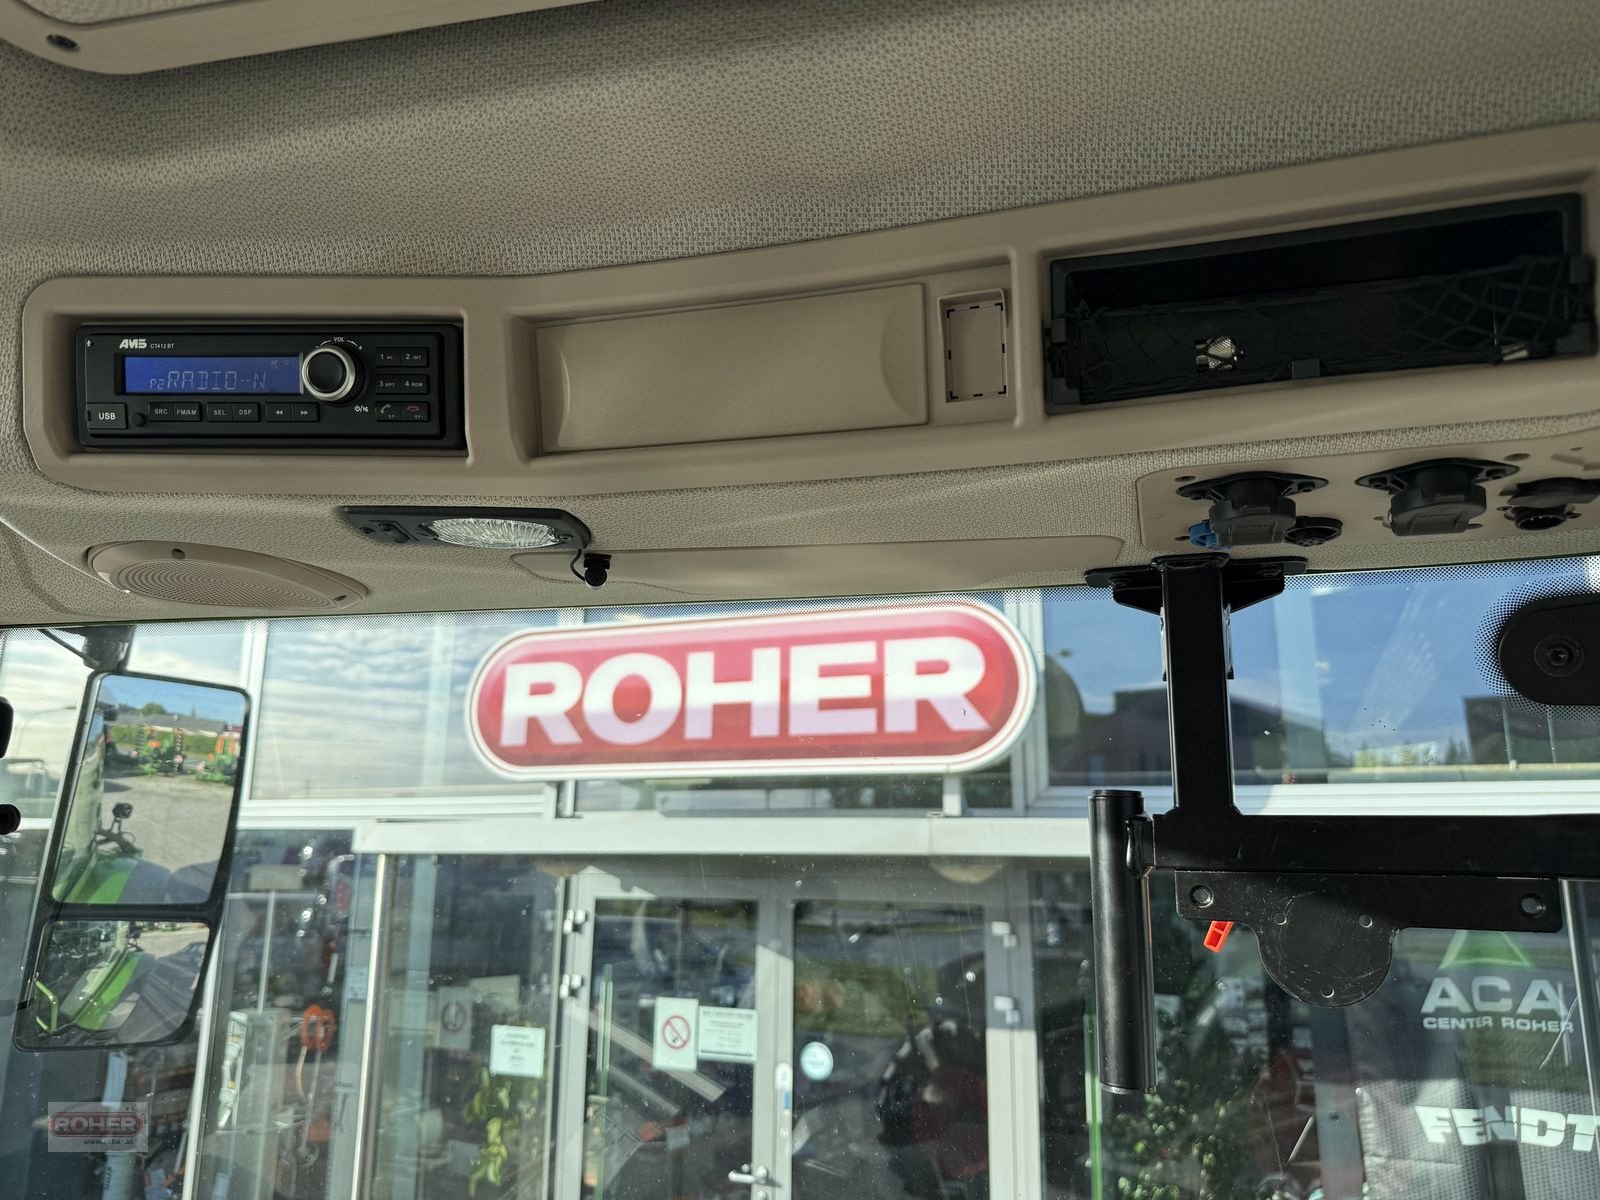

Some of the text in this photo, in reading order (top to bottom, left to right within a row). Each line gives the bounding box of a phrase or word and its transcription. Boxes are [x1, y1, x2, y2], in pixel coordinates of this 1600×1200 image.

[98, 412, 116, 421] USB
[500, 635, 990, 748] ROHER
[1420, 975, 1569, 1016] ACA
[1422, 1016, 1574, 1033] CENTER ROHER
[1414, 1105, 1600, 1152] FENDT
